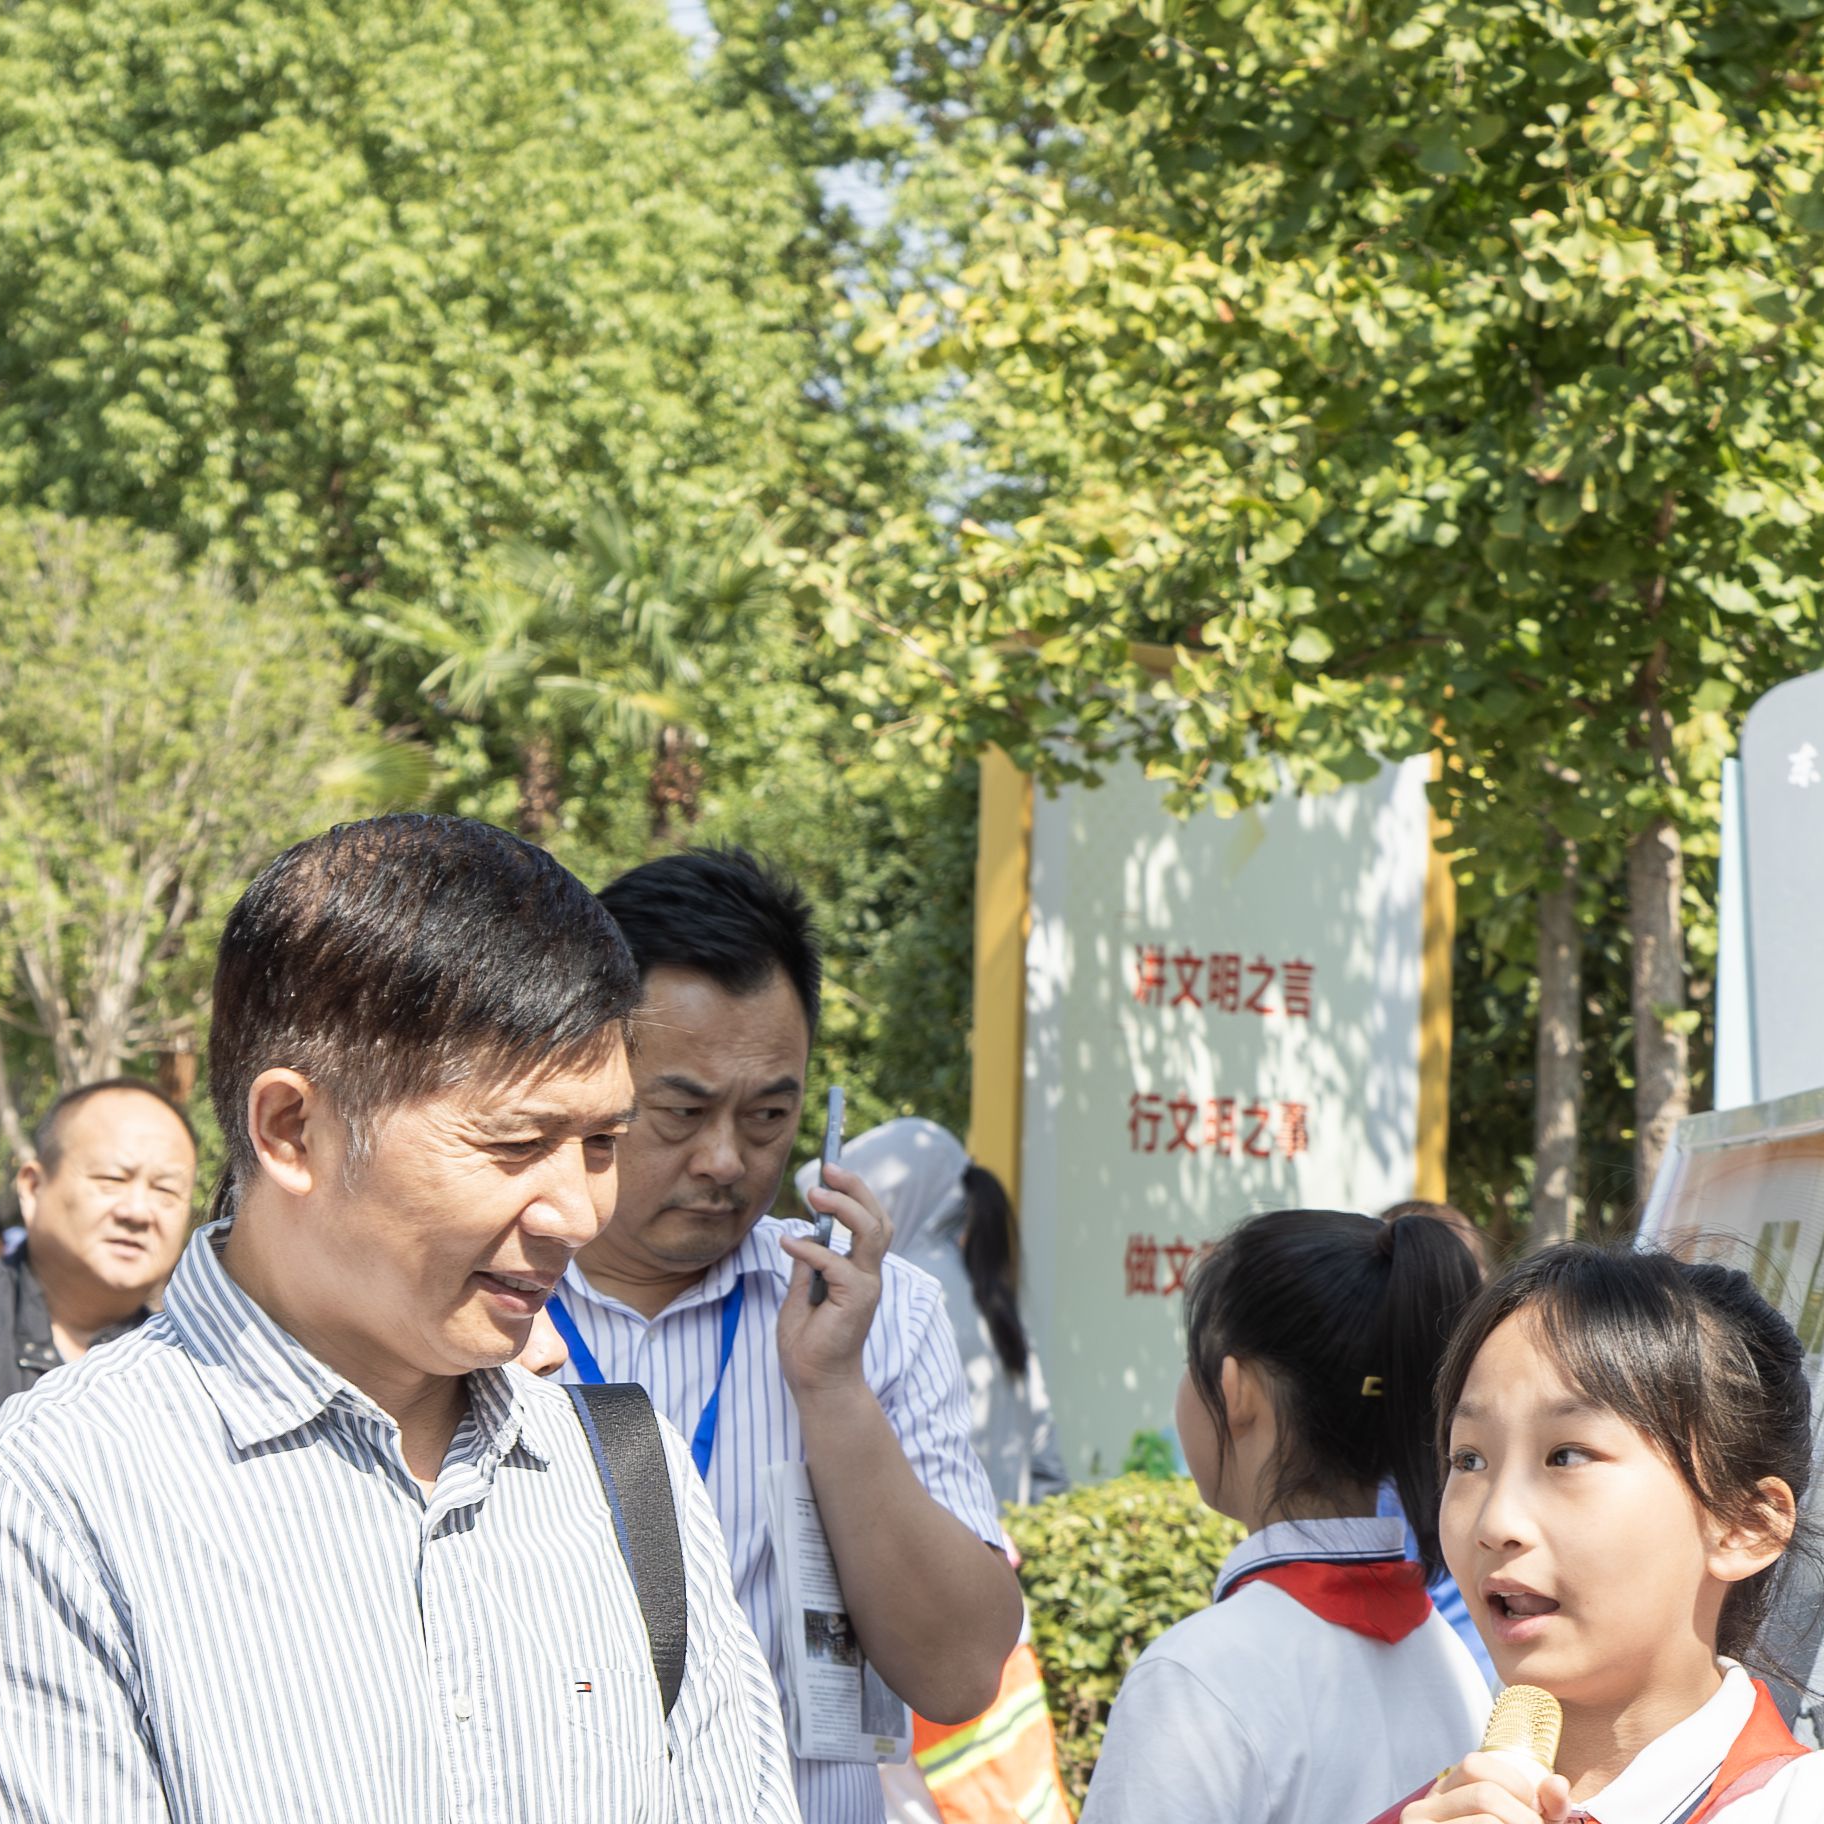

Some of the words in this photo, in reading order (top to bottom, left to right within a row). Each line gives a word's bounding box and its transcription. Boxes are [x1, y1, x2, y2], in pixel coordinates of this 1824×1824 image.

[1134, 943, 1315, 1020] 讲文明之言
[1128, 1091, 1309, 1161] 行文明之事
[1124, 1234, 1212, 1299] 做文
